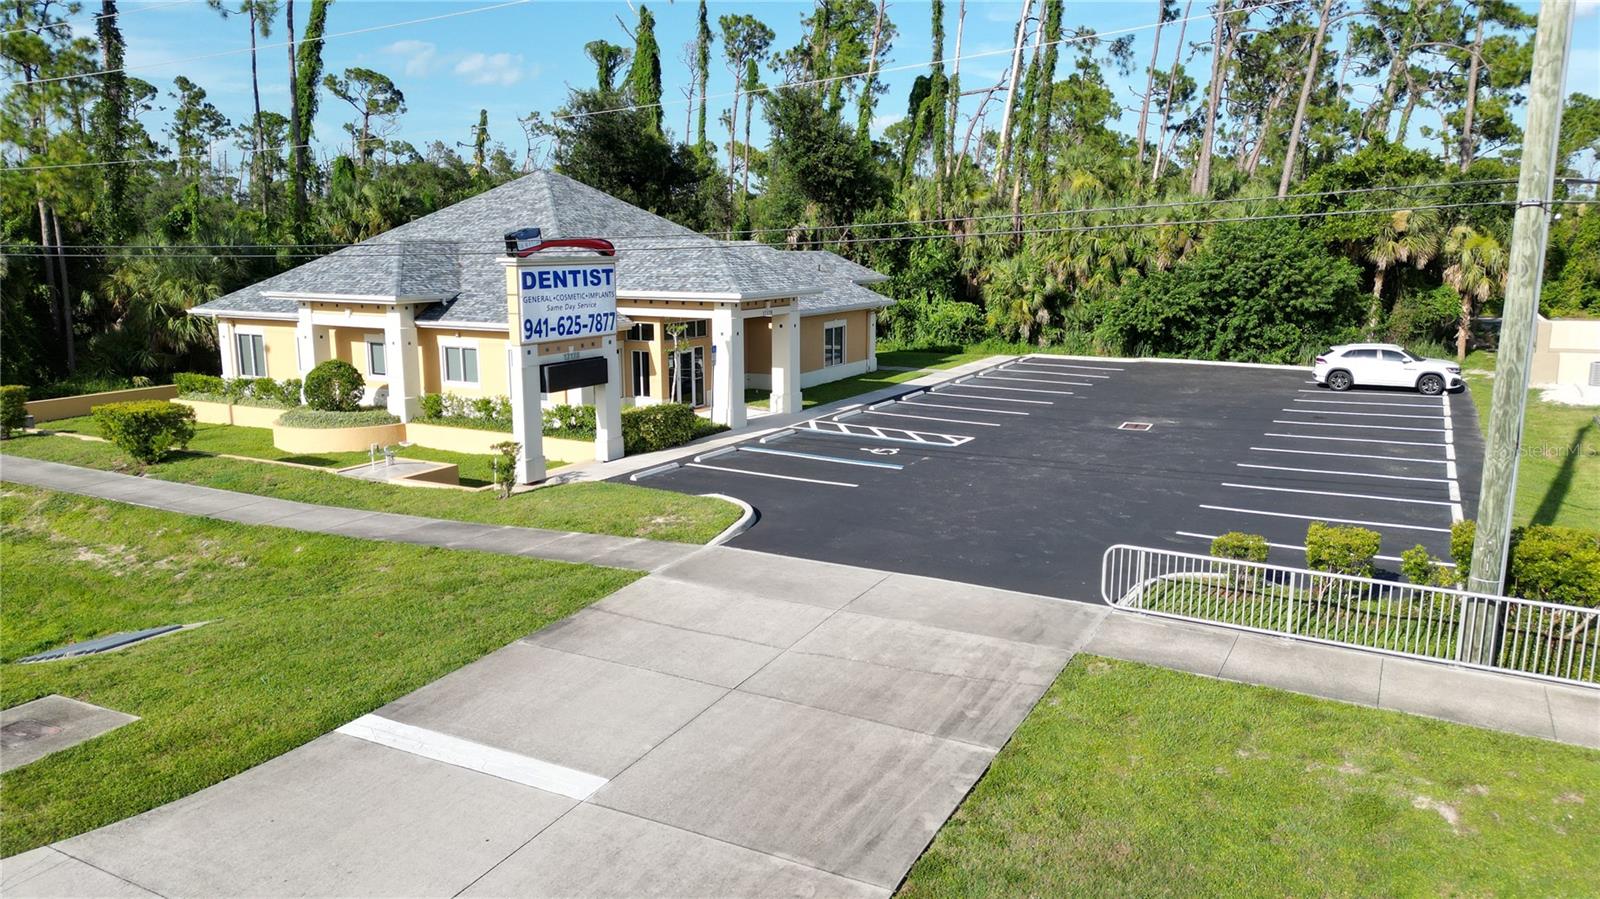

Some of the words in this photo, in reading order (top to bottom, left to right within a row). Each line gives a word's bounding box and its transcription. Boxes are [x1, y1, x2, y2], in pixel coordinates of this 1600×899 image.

[521, 268, 614, 290] DENTIST
[565, 303, 576, 311] Day
[577, 302, 597, 310] Service
[523, 312, 616, 340] 941-625-7877
